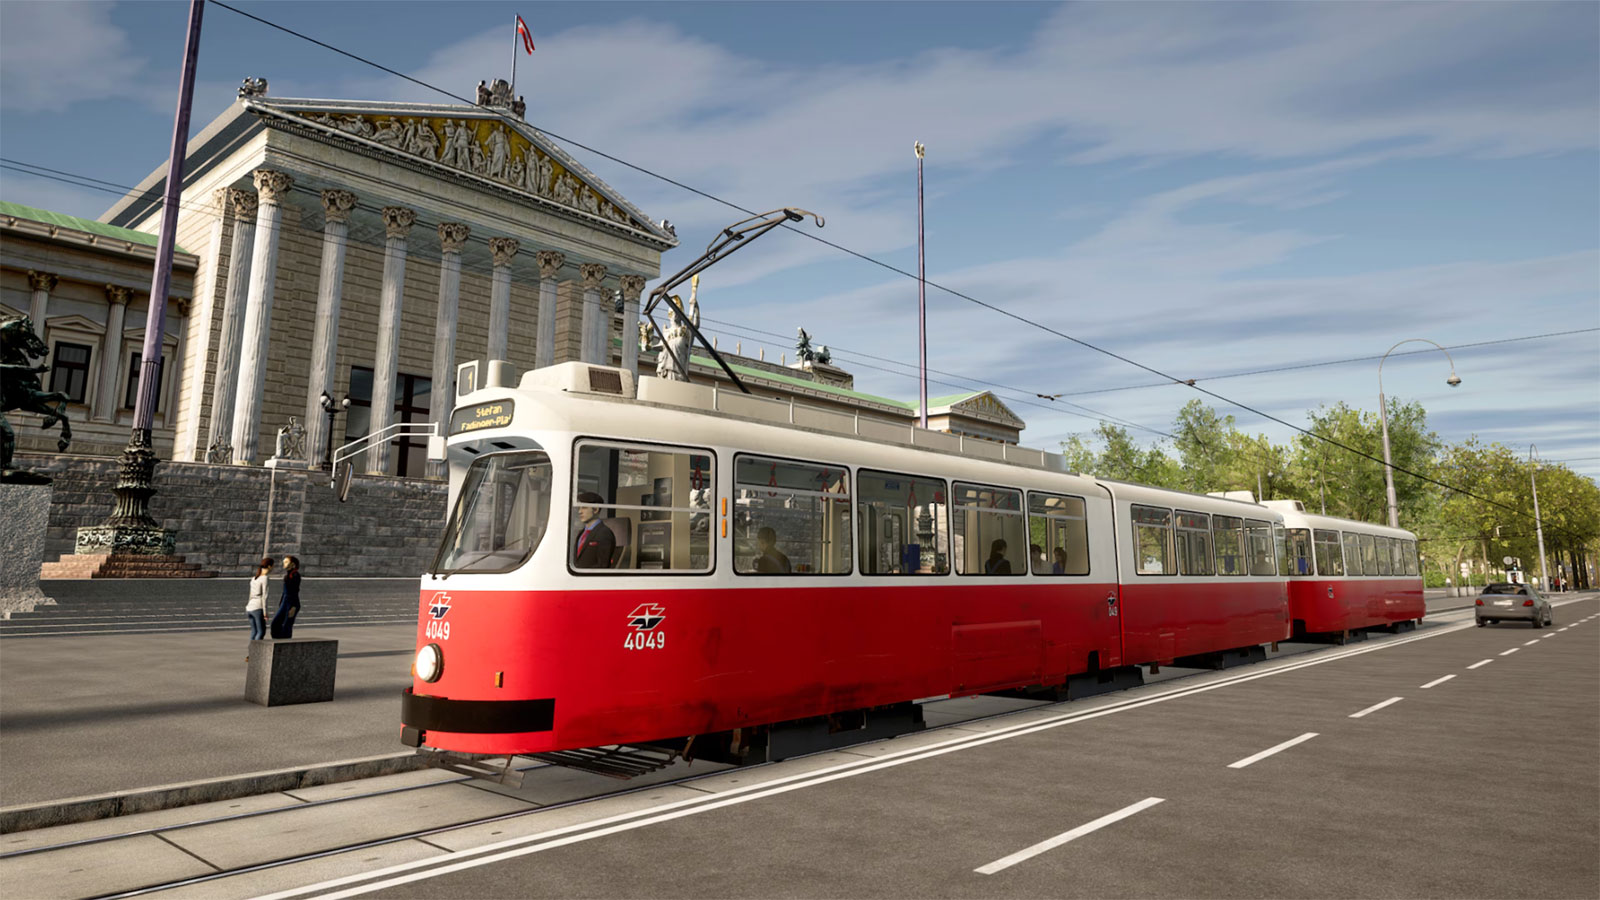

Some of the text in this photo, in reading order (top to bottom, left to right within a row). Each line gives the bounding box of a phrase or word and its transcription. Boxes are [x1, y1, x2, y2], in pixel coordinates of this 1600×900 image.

[468, 371, 473, 390] 1
[476, 405, 502, 417] Stefan
[425, 620, 450, 640] 4049
[624, 631, 665, 650] 4049
